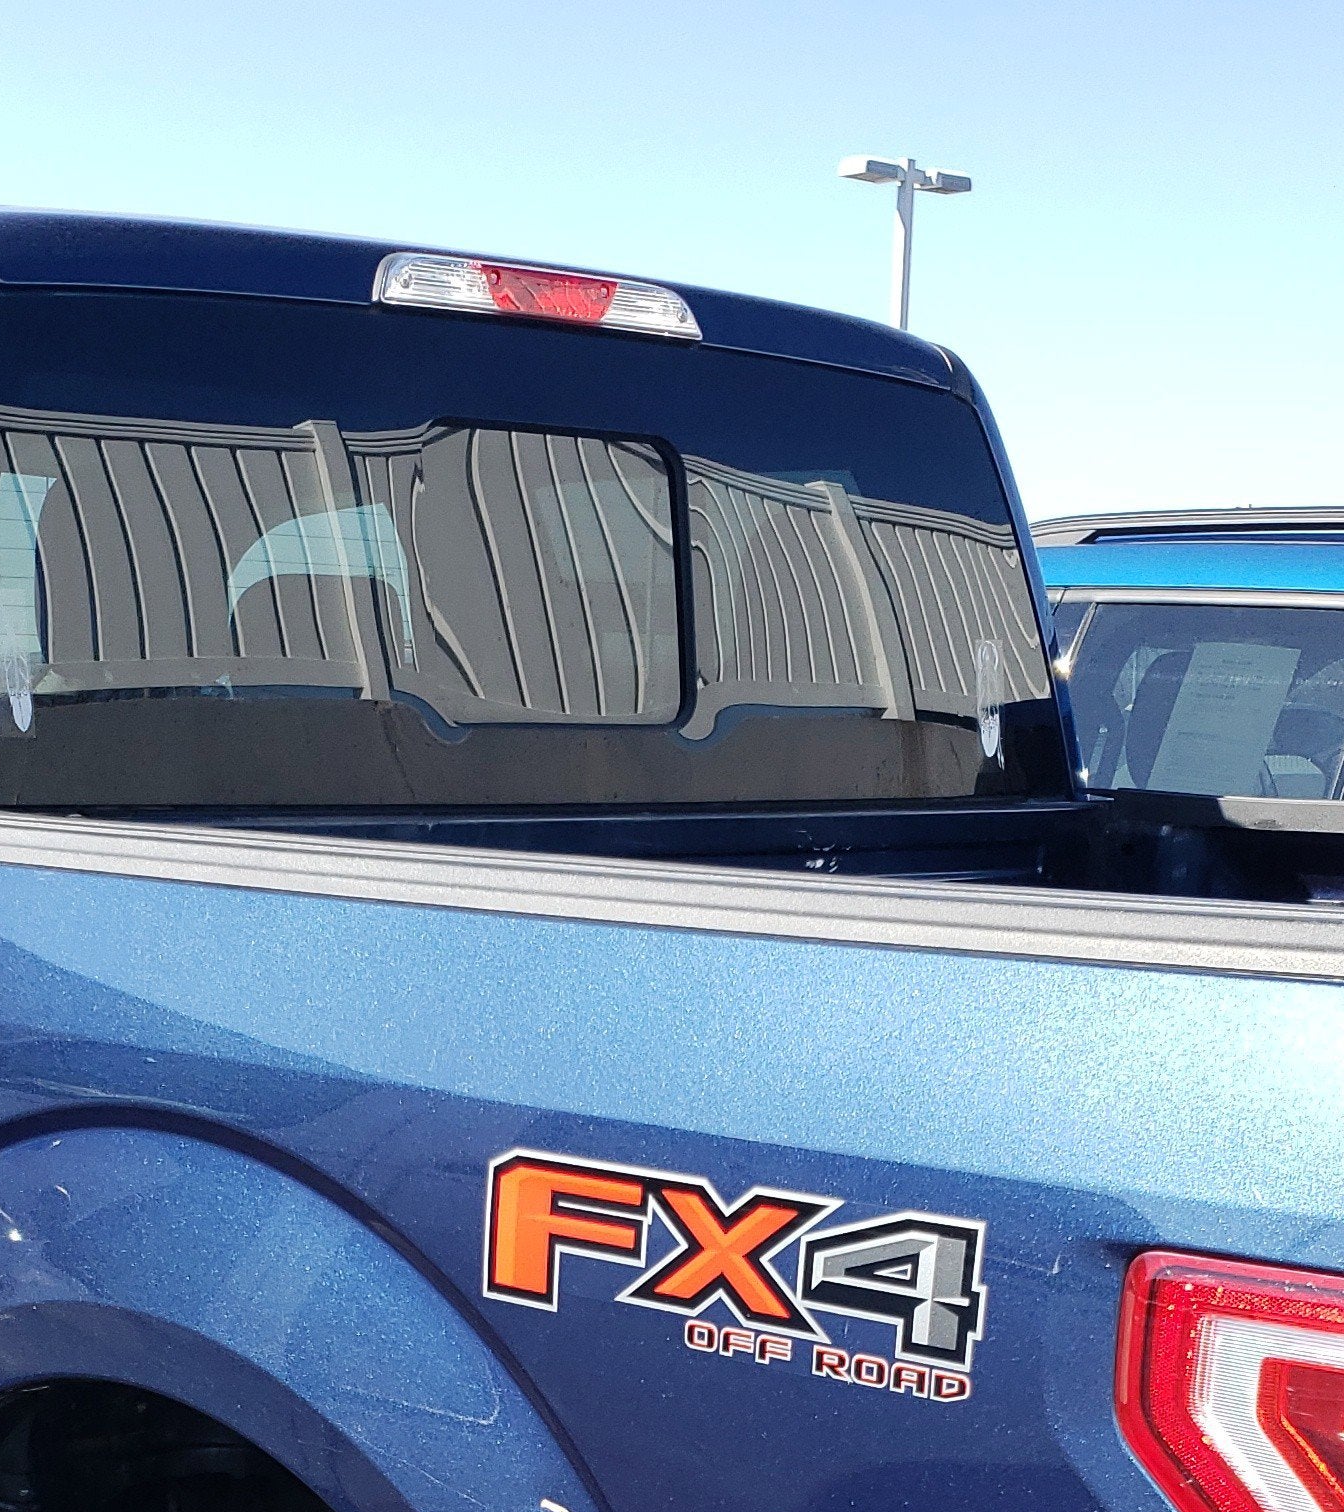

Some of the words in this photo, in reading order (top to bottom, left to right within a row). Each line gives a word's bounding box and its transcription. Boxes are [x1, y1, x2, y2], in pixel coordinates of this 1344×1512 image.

[483, 1148, 987, 1373] FX4
[684, 1320, 792, 1364] OFF
[812, 1343, 972, 1403] ROAD
